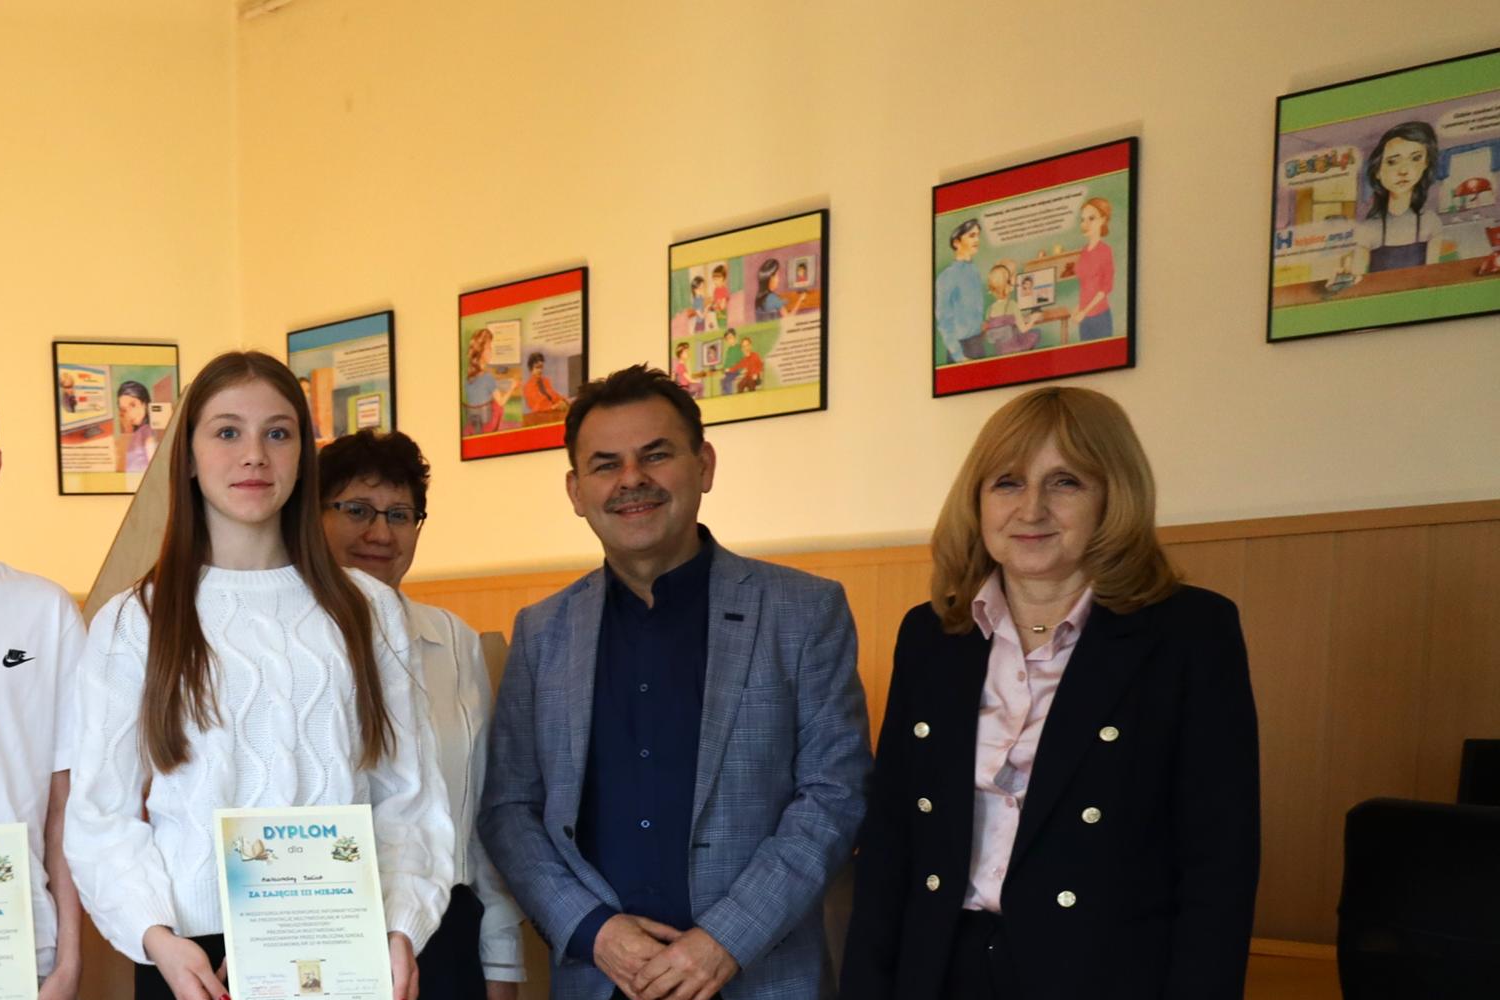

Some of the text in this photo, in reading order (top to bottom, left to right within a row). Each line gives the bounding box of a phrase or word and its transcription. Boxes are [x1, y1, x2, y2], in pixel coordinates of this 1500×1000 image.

[263, 824, 338, 840] DYPLOM
[287, 845, 304, 854] dla
[314, 887, 354, 896] MIEJSCA
